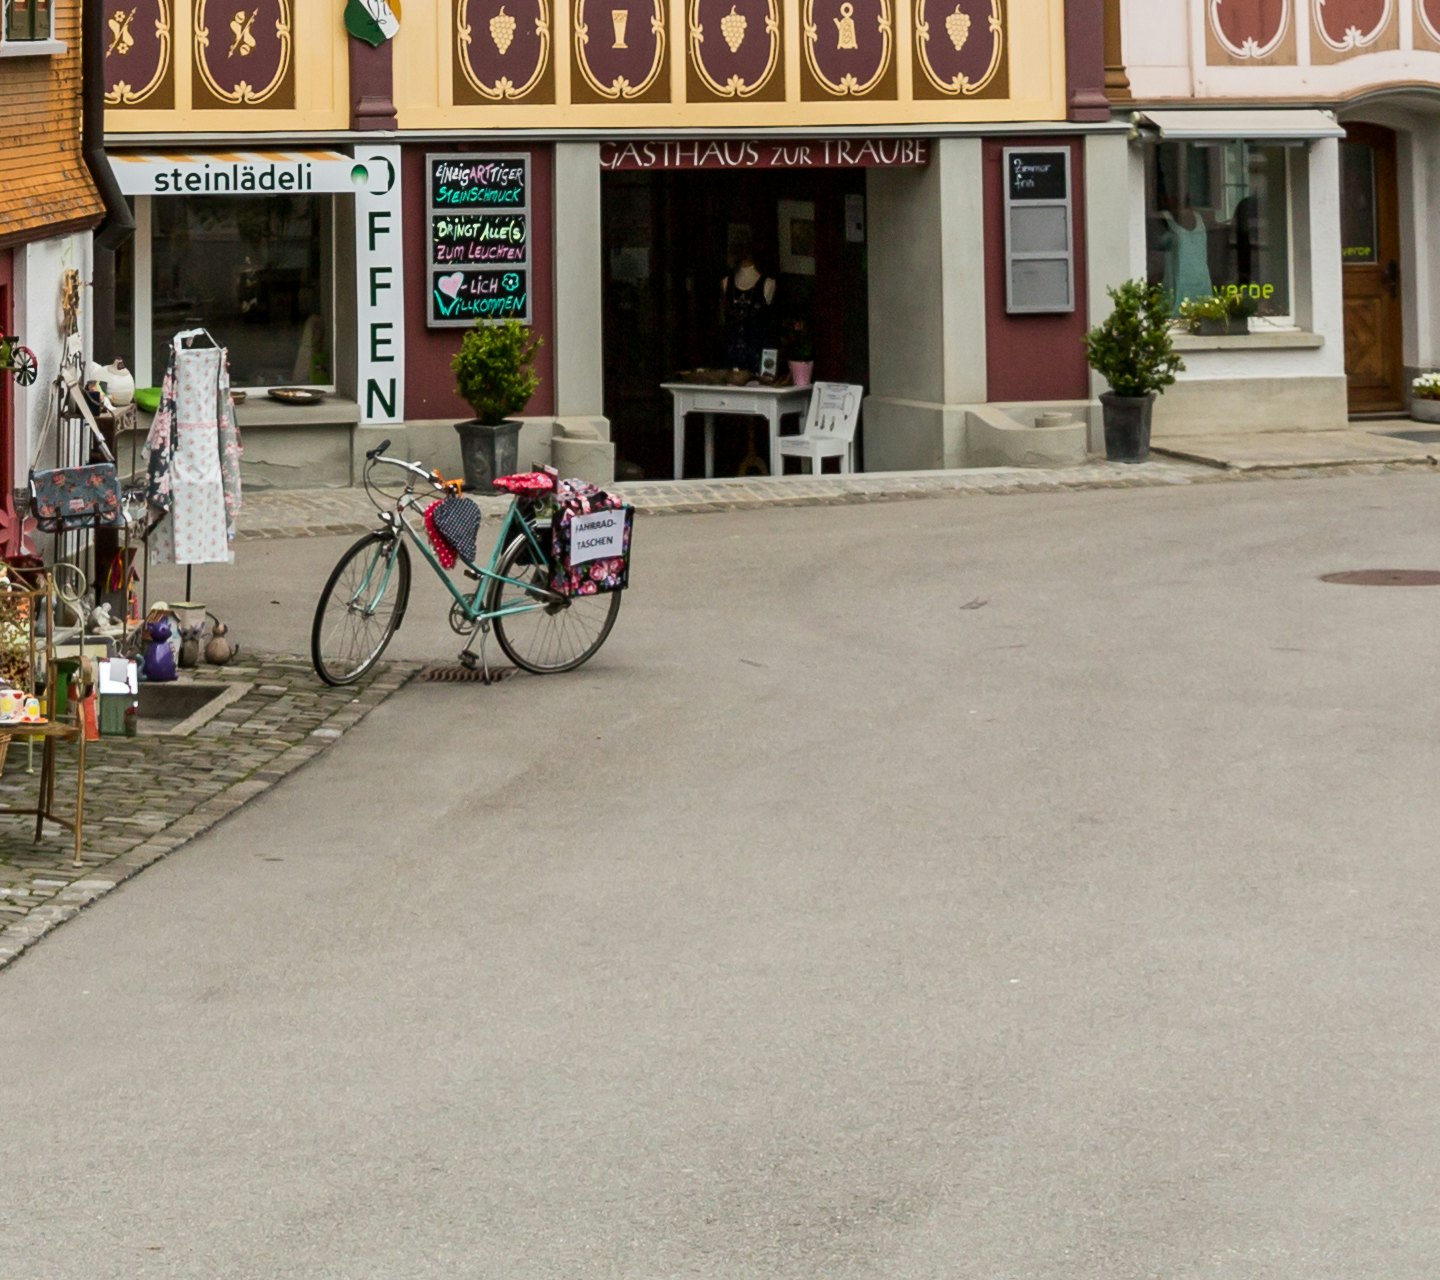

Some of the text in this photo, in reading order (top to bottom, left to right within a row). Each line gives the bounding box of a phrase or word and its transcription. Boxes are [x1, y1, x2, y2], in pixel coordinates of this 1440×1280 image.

[599, 139, 927, 169] GASTHAUS ZUR TRAUBE
[154, 163, 313, 191] steinlädeli
[577, 536, 614, 550] TASCHEN
